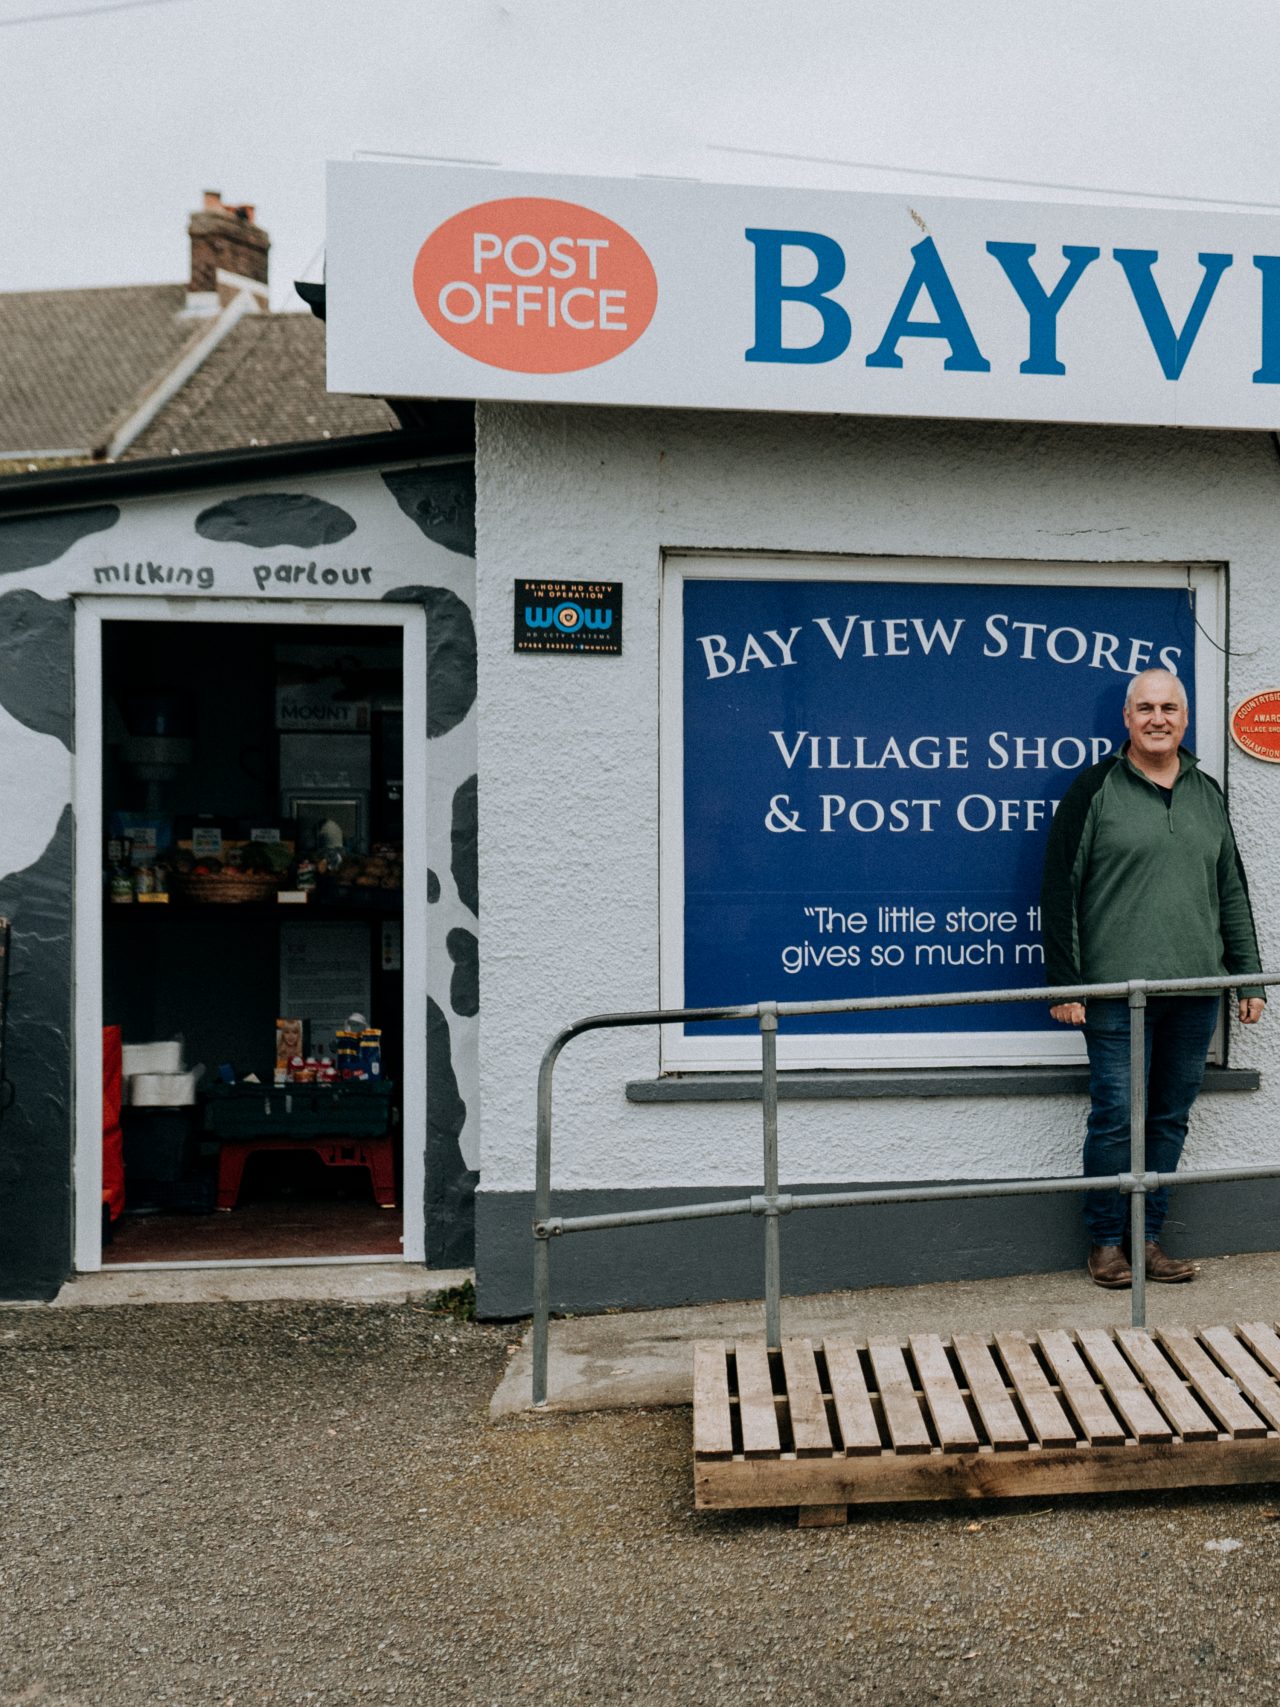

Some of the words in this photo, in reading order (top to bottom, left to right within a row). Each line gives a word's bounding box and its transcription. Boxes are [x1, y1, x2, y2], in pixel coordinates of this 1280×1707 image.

[473, 232, 609, 280] POST
[438, 281, 628, 331] OFFICE
[93, 561, 215, 589] milking
[253, 561, 373, 591] parlour
[697, 626, 802, 680] BAY
[812, 615, 966, 660] VIEW
[983, 614, 1182, 676] STORES
[281, 705, 349, 720] MOUNT
[768, 731, 969, 769] VILLAGE
[987, 731, 1113, 770] SHOP
[1240, 734, 1280, 757] CHAMPION
[764, 794, 807, 833] &
[819, 794, 941, 833] POST
[956, 794, 1060, 833] OFF
[878, 907, 936, 933] little
[945, 906, 1018, 933] store
[781, 940, 861, 974] gives
[870, 945, 905, 967] so
[915, 939, 1004, 966] much
